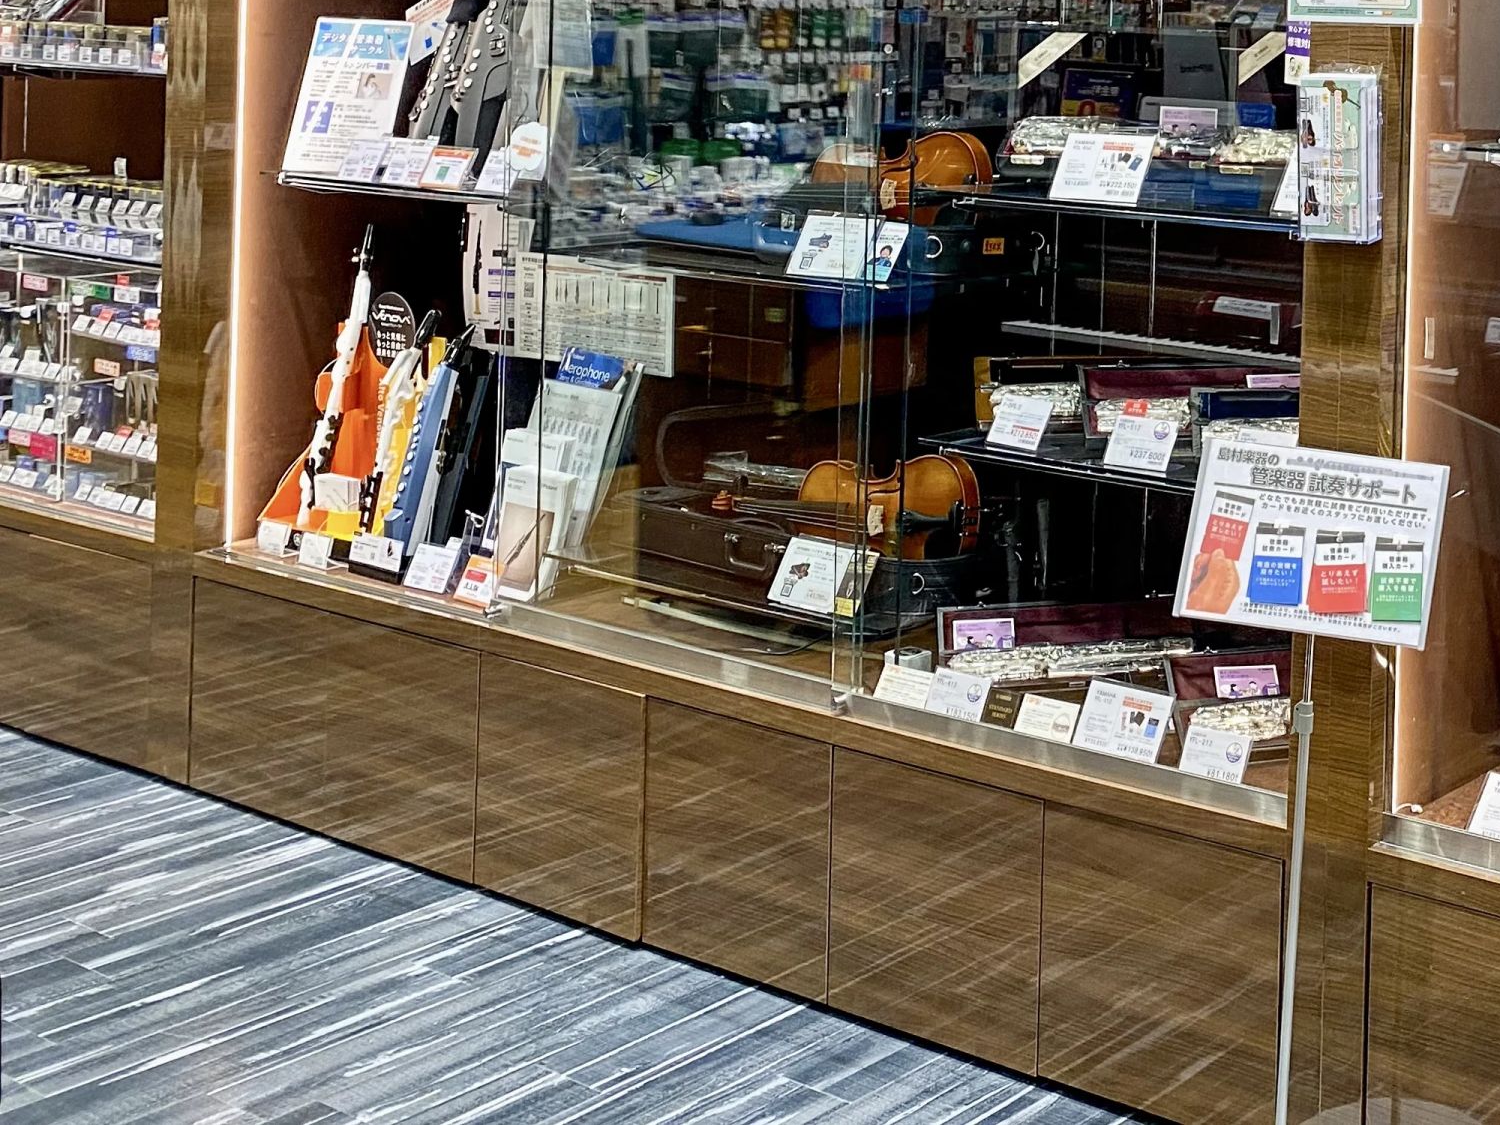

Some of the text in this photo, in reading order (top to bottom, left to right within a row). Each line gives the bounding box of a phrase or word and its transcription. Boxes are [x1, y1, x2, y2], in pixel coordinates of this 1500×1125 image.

[1217, 447, 1280, 467] 島村楽器の
[1250, 466, 1418, 505] 管楽器 試奏サポート
